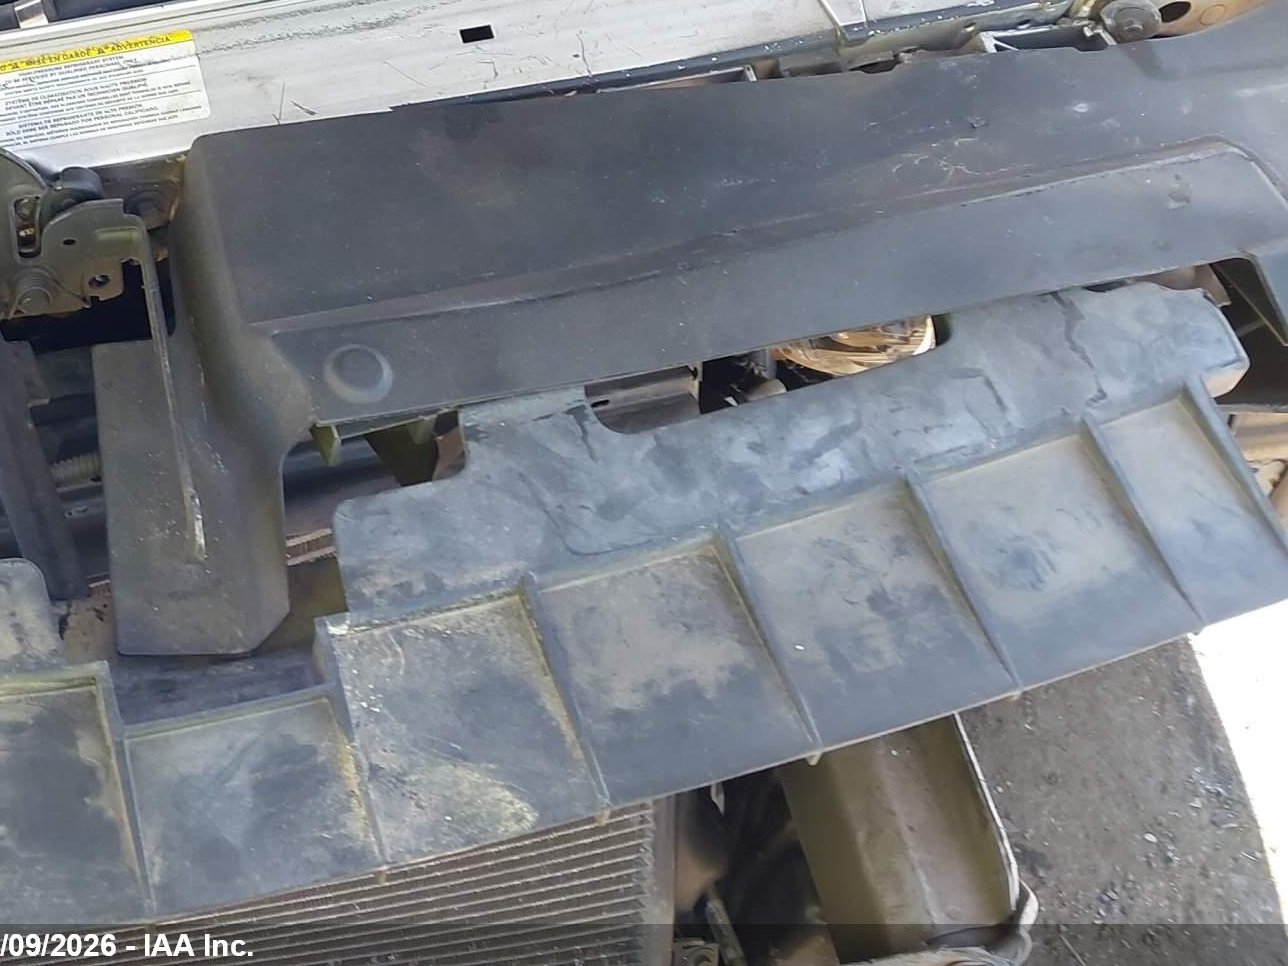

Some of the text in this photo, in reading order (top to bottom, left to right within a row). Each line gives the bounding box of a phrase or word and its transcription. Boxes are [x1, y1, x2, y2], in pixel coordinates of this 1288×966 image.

[49, 54, 61, 62] EN
[63, 49, 89, 60] GARDE
[111, 35, 169, 51] ADVERTENCIA
